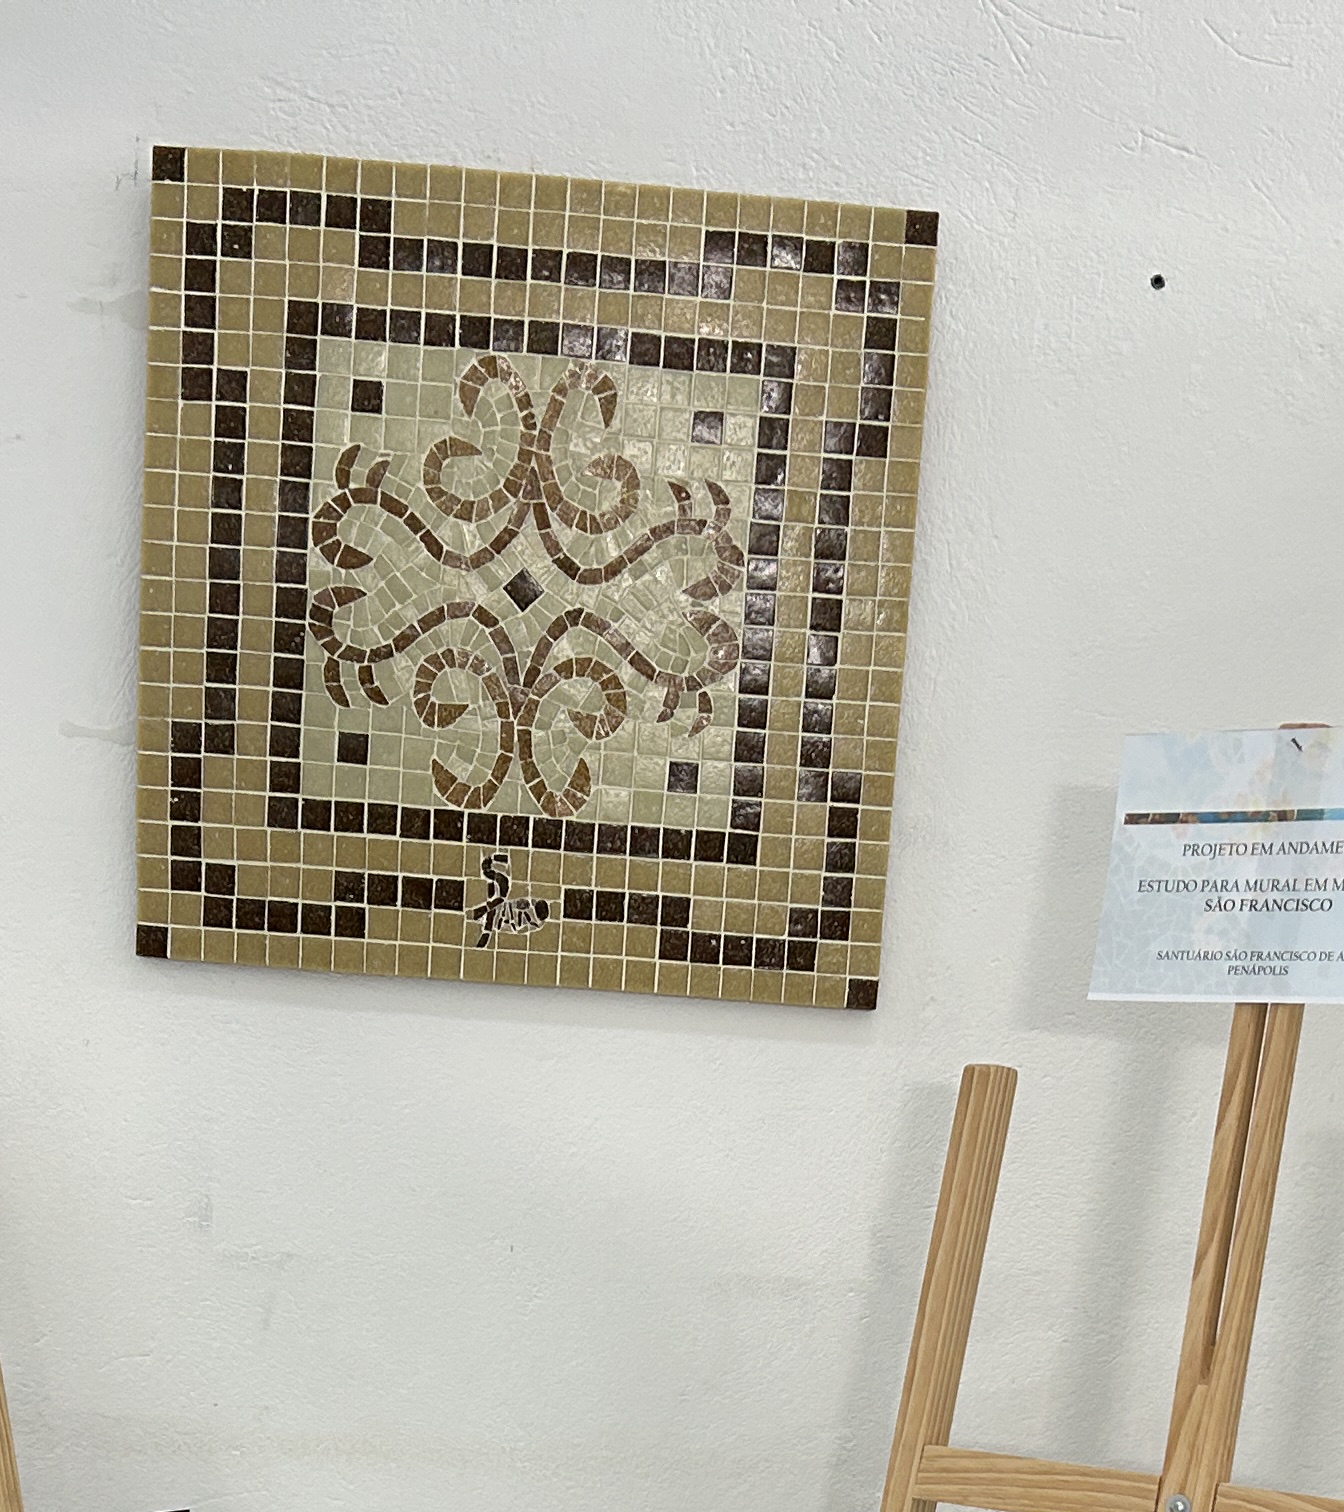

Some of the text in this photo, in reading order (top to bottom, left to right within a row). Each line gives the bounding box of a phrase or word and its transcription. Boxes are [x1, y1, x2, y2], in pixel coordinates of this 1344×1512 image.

[1182, 842, 1247, 860] PROJETO
[1251, 842, 1274, 856] EM
[1138, 879, 1197, 893] ESTUDO
[1200, 879, 1240, 893] PARA
[1244, 878, 1301, 892] MURAL
[1304, 878, 1328, 891] EM
[1204, 896, 1333, 912] SÃO FRANCISCO
[1156, 950, 1222, 962] SANTUÁRIO
[1225, 950, 1247, 962] SÃO
[1250, 950, 1316, 962] FRANCISCO
[1319, 951, 1335, 962] DE
[1227, 963, 1289, 976] PENÁPOLIS
